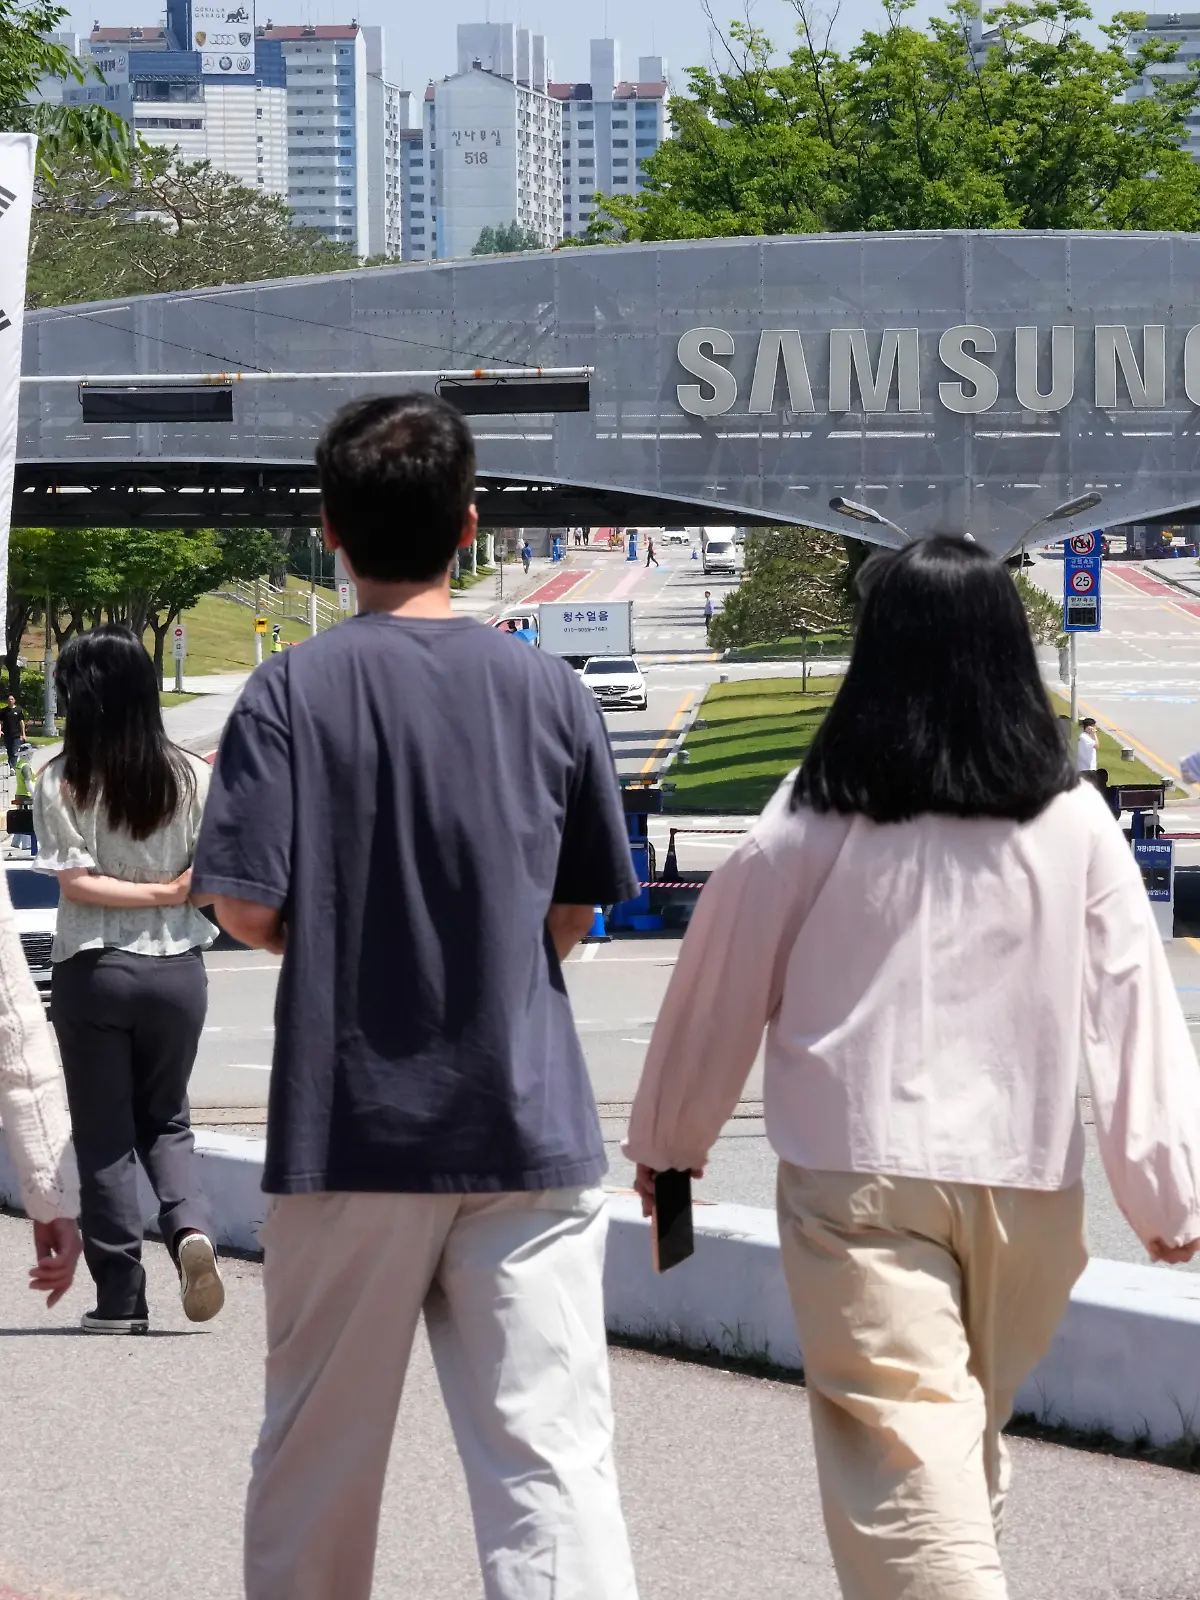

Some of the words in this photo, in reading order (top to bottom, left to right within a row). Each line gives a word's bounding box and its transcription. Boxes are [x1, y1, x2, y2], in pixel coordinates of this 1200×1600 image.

[451, 130, 501, 146] 신나무실
[464, 151, 488, 165] 518
[676, 324, 1200, 416] SAMSUN
[1075, 576, 1090, 587] 25
[563, 610, 609, 623] 청수얼음
